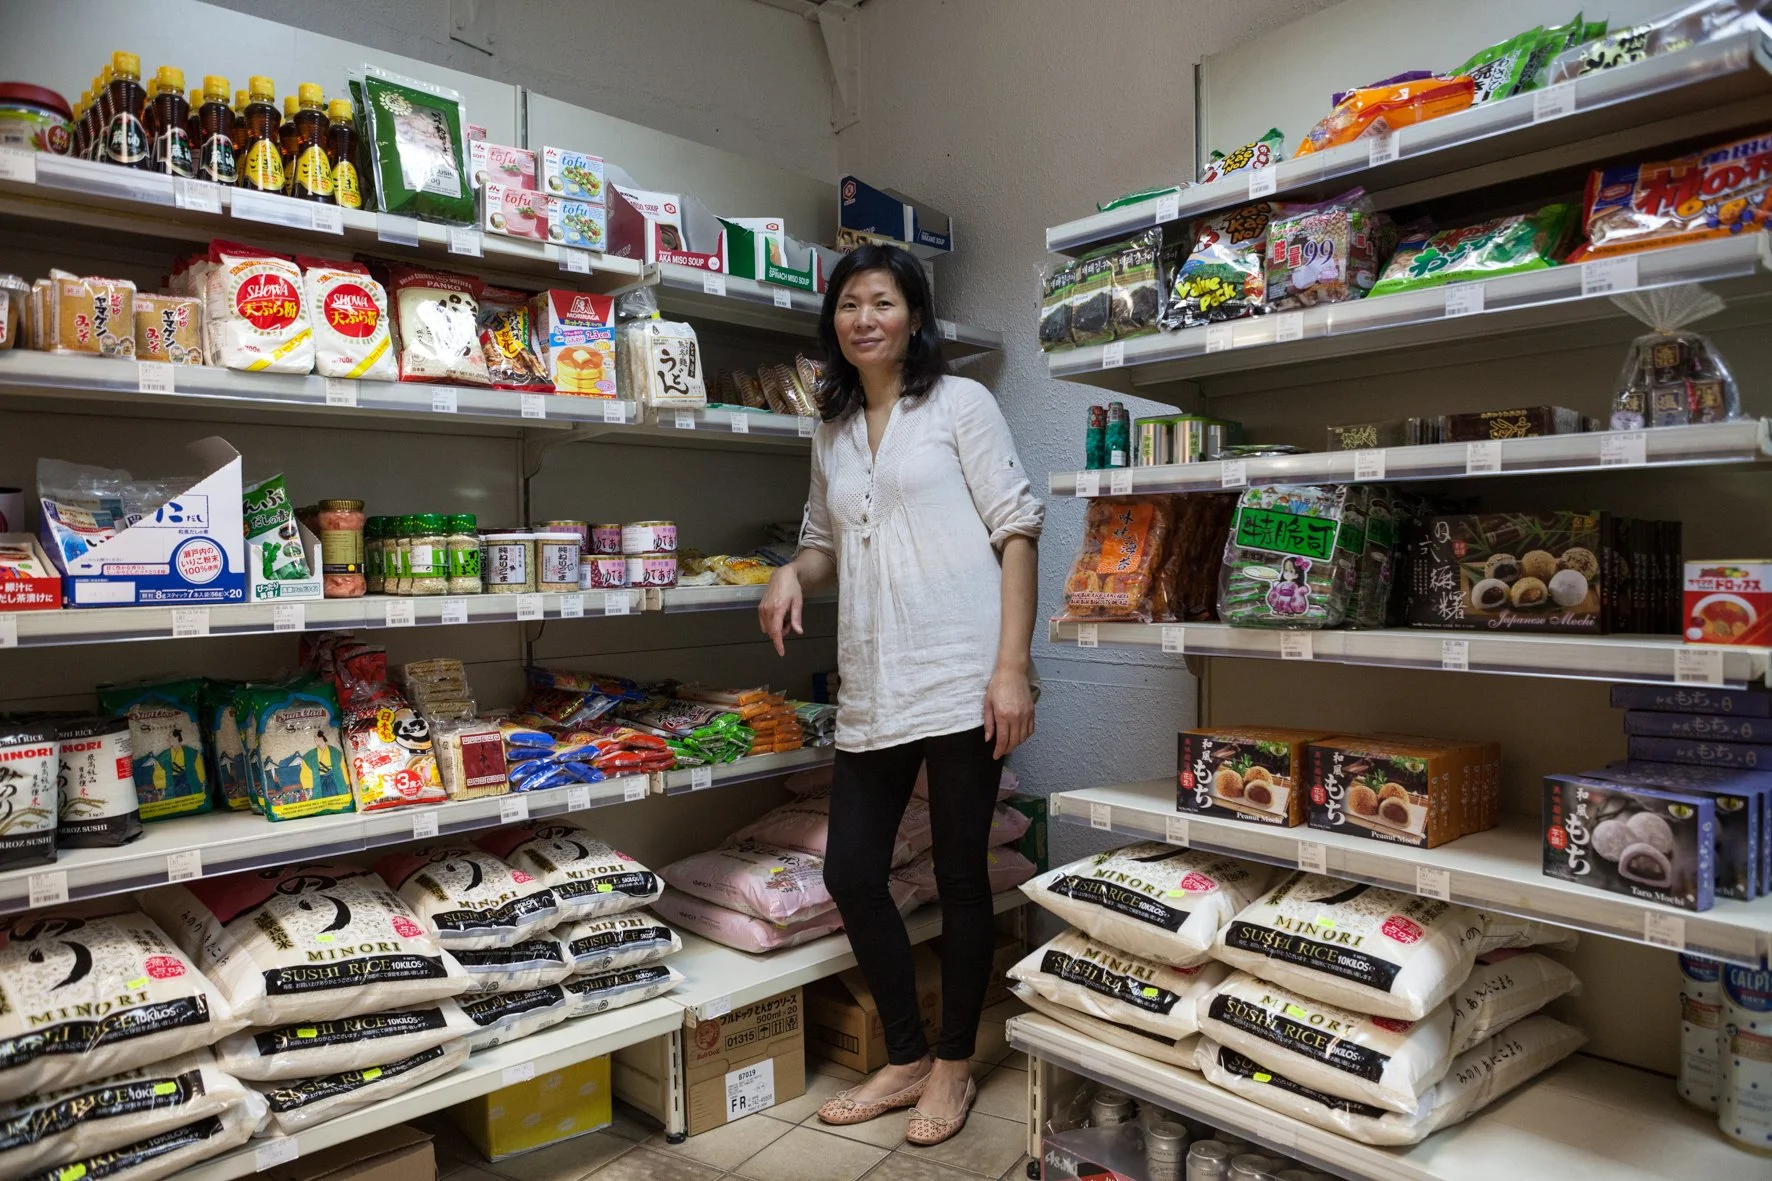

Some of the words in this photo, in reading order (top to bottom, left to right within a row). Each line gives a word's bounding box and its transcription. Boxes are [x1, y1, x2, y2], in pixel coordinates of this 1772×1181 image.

[490, 150, 517, 166] tofu
[561, 156, 588, 170] tofu
[505, 191, 531, 207] tofu
[562, 203, 589, 218] tofu
[659, 254, 671, 263] AKA
[672, 255, 687, 265] MISO
[688, 257, 704, 267] SOUP
[1304, 240, 1334, 266] 99
[769, 269, 787, 280] SPINACH
[246, 283, 289, 298] SHOWA
[427, 280, 461, 291] PANKO
[1177, 276, 1221, 299] Value
[333, 293, 369, 308] SHOWA
[1200, 282, 1237, 312] Pack
[94, 296, 108, 337] ヤマゲン
[244, 301, 297, 318] 天ぷら粉
[331, 309, 377, 327] 天ぷら粉
[566, 312, 600, 321] MORINAGA
[75, 314, 91, 342] みそ
[145, 327, 160, 354] みそ
[181, 555, 219, 568] いりこ粉末
[183, 547, 214, 559] 瀬戸内の
[1488, 610, 1546, 629] Japanese
[1550, 611, 1598, 627] Mochi
[24, 734, 44, 743] RICE
[75, 728, 93, 737] RICE
[1236, 812, 1260, 822] Peanut
[1260, 814, 1283, 825] Mochi
[83, 824, 107, 833] SUSHI
[26, 836, 52, 847] SUSHI
[1371, 831, 1396, 841] Peanut
[1396, 834, 1420, 845] Mochi
[566, 864, 626, 880] MINORI
[1093, 869, 1165, 899] MINORI
[457, 890, 519, 911] MINORI
[1109, 886, 1140, 907] RICE
[1630, 885, 1652, 899] Taro
[1653, 891, 1685, 907] Mochi
[443, 913, 482, 923] SUSHI
[1274, 914, 1365, 948] MINORI
[307, 941, 402, 962] MINORI
[578, 936, 613, 950] SUSHI
[1239, 926, 1292, 951] SUSHI
[1299, 940, 1340, 963] RICE
[1337, 954, 1370, 972] 10KILOS
[280, 965, 341, 983] SUSHI
[349, 958, 391, 976] RICE
[391, 960, 422, 970] 10KILOS
[1054, 955, 1098, 980] SUSHI
[1083, 948, 1157, 981] MINORI
[27, 991, 149, 1028] MINORI
[720, 1010, 754, 1026] ブルドック
[754, 994, 797, 1015] とんかつソース
[757, 1010, 782, 1024] 500ml
[787, 1006, 798, 1016] 20
[1261, 995, 1355, 1036] MIORI
[343, 1016, 387, 1032] RICE
[387, 1015, 419, 1026] 10KILOS
[1224, 998, 1279, 1030] SUSHI
[1285, 1023, 1328, 1051] RICE
[727, 1031, 756, 1047] 01315
[738, 1068, 756, 1081] 87019
[70, 1088, 130, 1114] RICE
